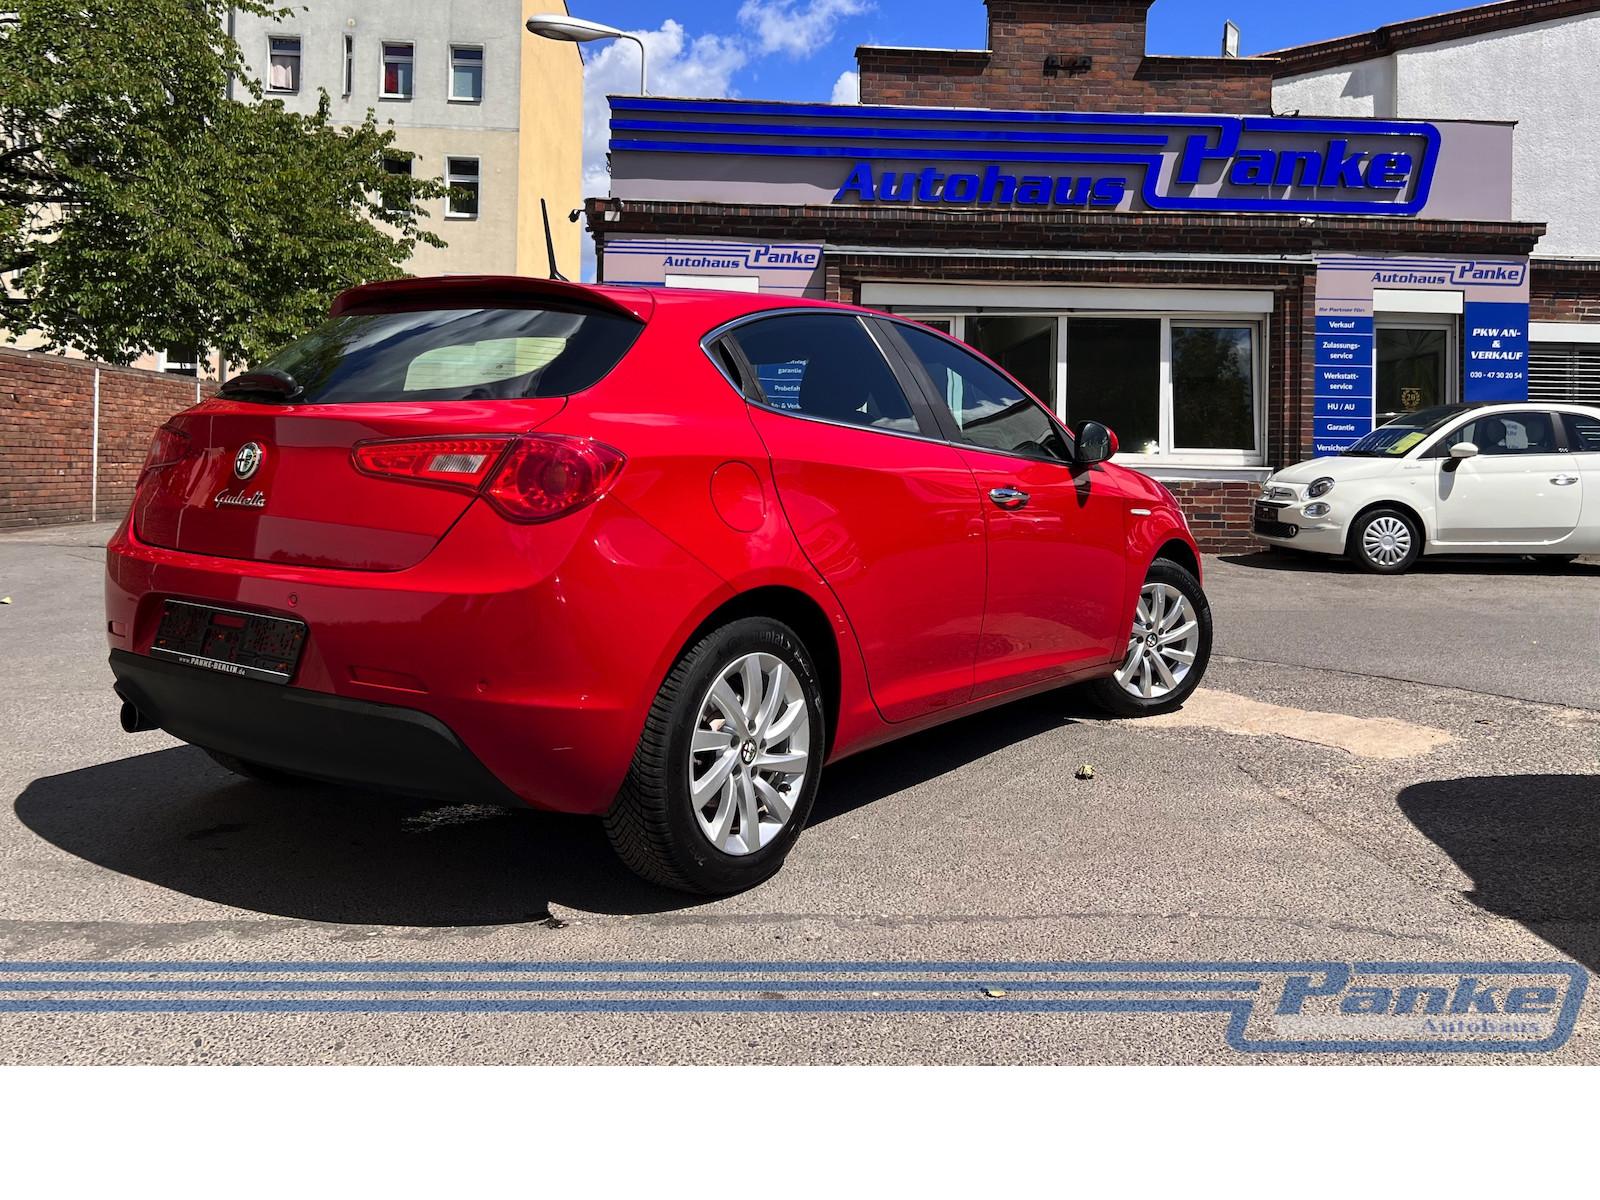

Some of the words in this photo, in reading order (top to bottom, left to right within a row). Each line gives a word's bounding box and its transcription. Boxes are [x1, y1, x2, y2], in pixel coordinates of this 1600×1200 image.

[832, 162, 1126, 205] Autohaus
[1175, 118, 1413, 190] Panke
[663, 256, 740, 269] Autohaus
[754, 246, 816, 264] Panke
[1371, 272, 1446, 284] Autohaus
[1459, 263, 1518, 281] Panke
[1472, 328, 1499, 336] PKW
[1500, 329, 1521, 337] AN-
[1322, 341, 1360, 350] Zulassungs-
[1491, 340, 1501, 348] &
[1471, 351, 1523, 360] VERKAUF
[1324, 372, 1359, 380] Werkstatt-
[1470, 371, 1482, 379] 030
[1487, 371, 1495, 379] 47
[1496, 371, 1504, 379] 30
[214, 488, 266, 508] Giulietta
[179, 657, 246, 675] www.PANKE-BERLIN.de
